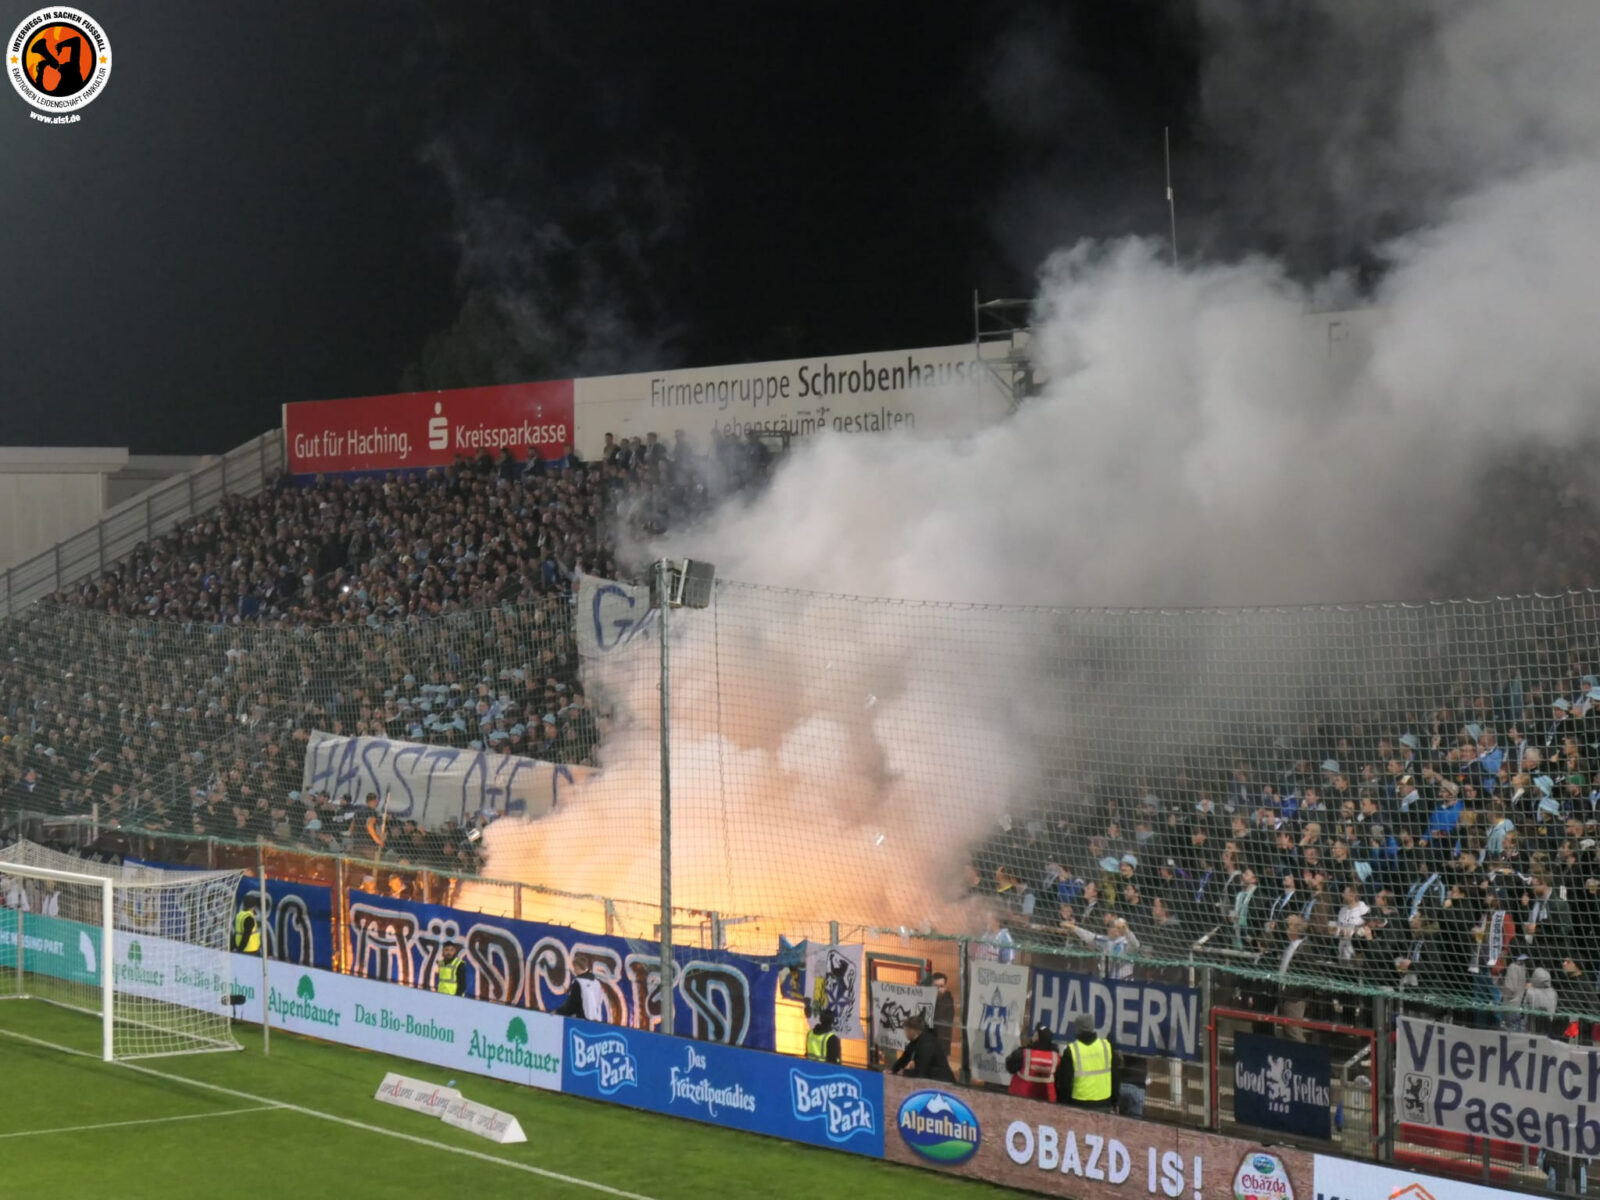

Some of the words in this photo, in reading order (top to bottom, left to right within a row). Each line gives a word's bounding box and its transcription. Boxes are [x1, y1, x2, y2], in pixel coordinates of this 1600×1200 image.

[651, 376, 791, 410] Firmengruppe
[295, 433, 320, 458] Gut
[323, 430, 344, 457] für
[348, 427, 412, 460] Haching.
[456, 420, 567, 449] Kreissparkasse
[268, 986, 340, 1028] Alpenbauer
[355, 1004, 377, 1028] Das
[381, 1008, 455, 1044] Bio-Bonbon
[1032, 974, 1198, 1055] HADERN
[467, 1029, 560, 1074] Alpenbauer
[573, 1034, 626, 1070] Bayern
[684, 1045, 706, 1074] Das
[601, 1057, 634, 1088] Park
[1235, 1061, 1266, 1096] Good
[1293, 1074, 1330, 1107] Fellas
[669, 1067, 756, 1118] Freizeitparadies
[794, 1075, 859, 1114] Bayern
[828, 1101, 872, 1135] Park
[900, 1109, 978, 1143] Alpenhain
[1005, 1120, 1131, 1185] OBAZD
[1147, 1146, 1203, 1200] IS!
[1241, 1173, 1286, 1193] Obazda
